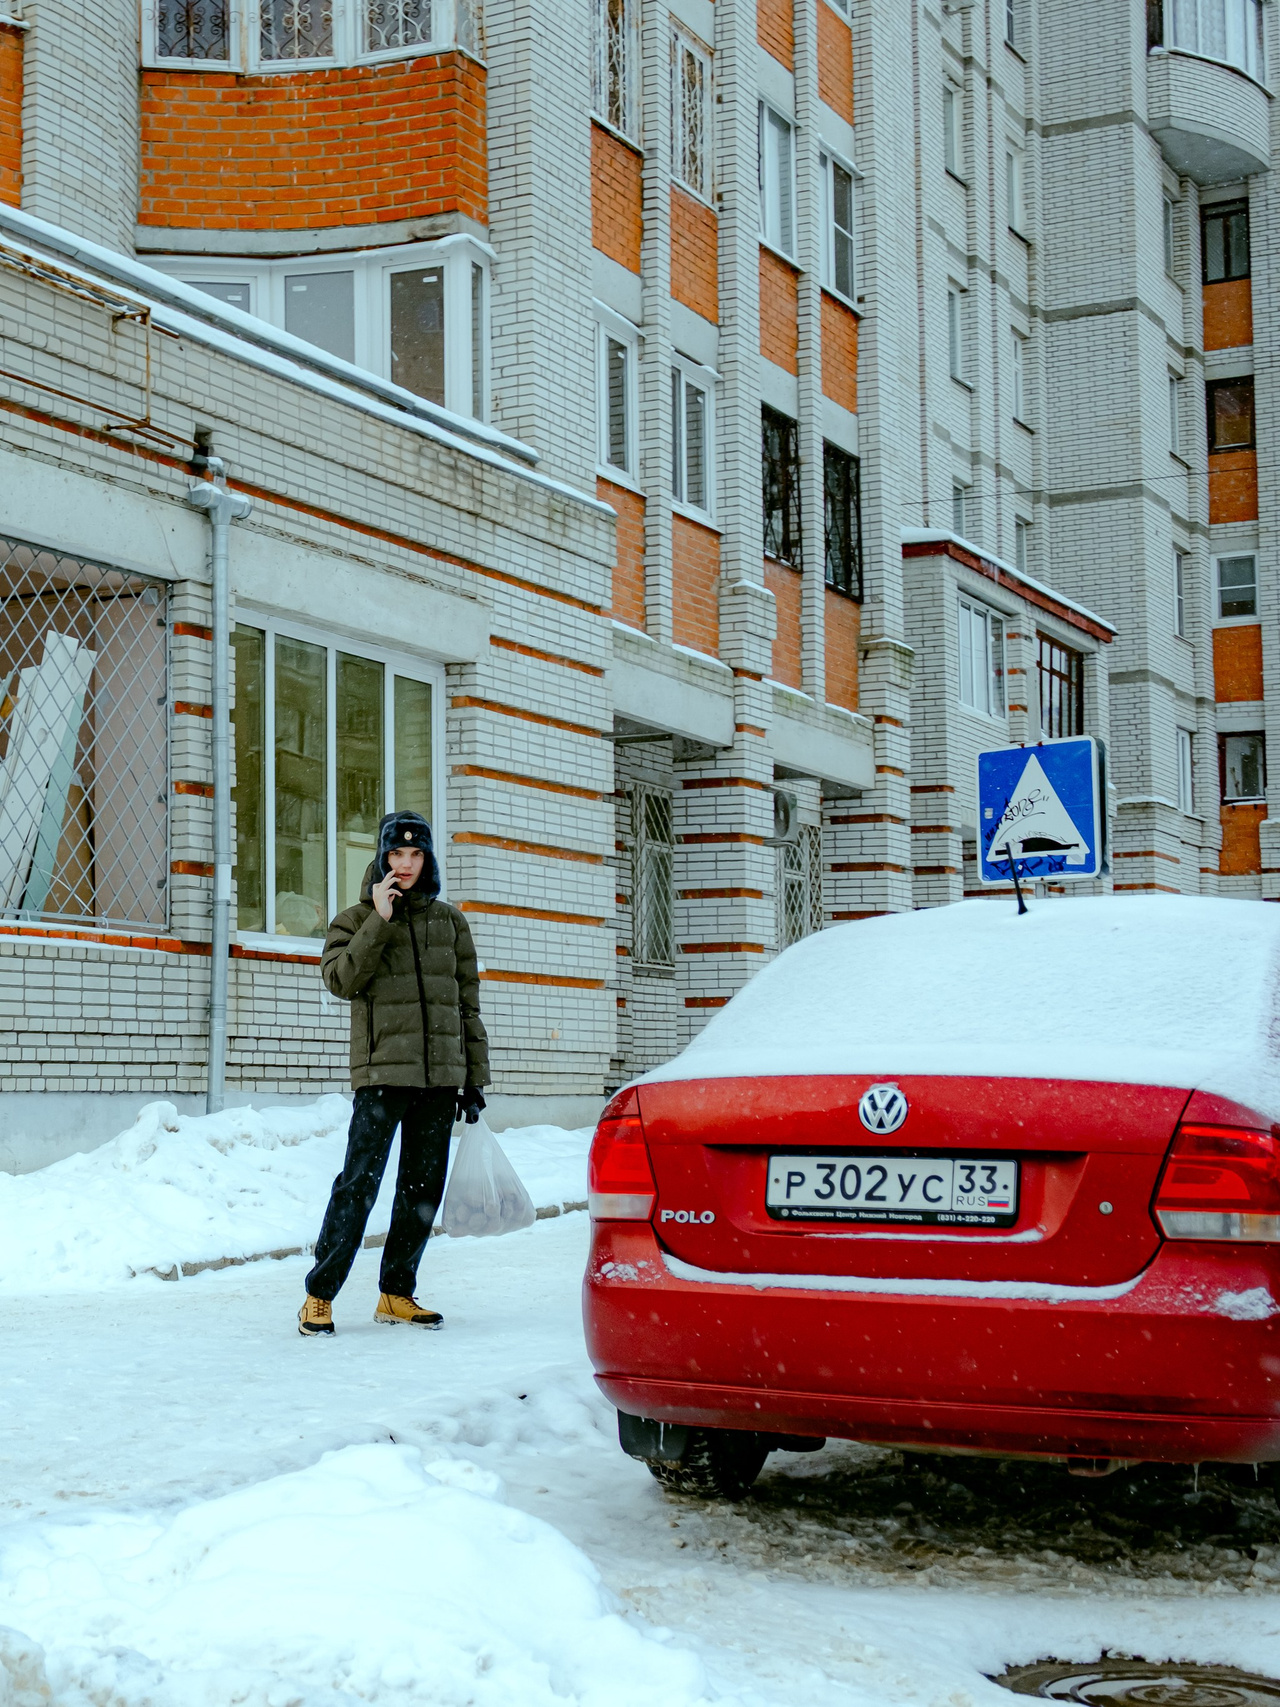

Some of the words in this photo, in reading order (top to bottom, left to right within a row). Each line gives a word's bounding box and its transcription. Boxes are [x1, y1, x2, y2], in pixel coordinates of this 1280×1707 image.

[958, 1165, 997, 1194] 33
[956, 1195, 986, 1206] RUS
[661, 1209, 715, 1224] POLO
[791, 1209, 834, 1218] Фольксваген
[836, 1211, 857, 1219] Центр
[859, 1211, 887, 1219] Нижний
[889, 1212, 923, 1221] Новгород
[937, 1214, 956, 1222] (831)
[957, 1215, 996, 1223] 4-220-220
